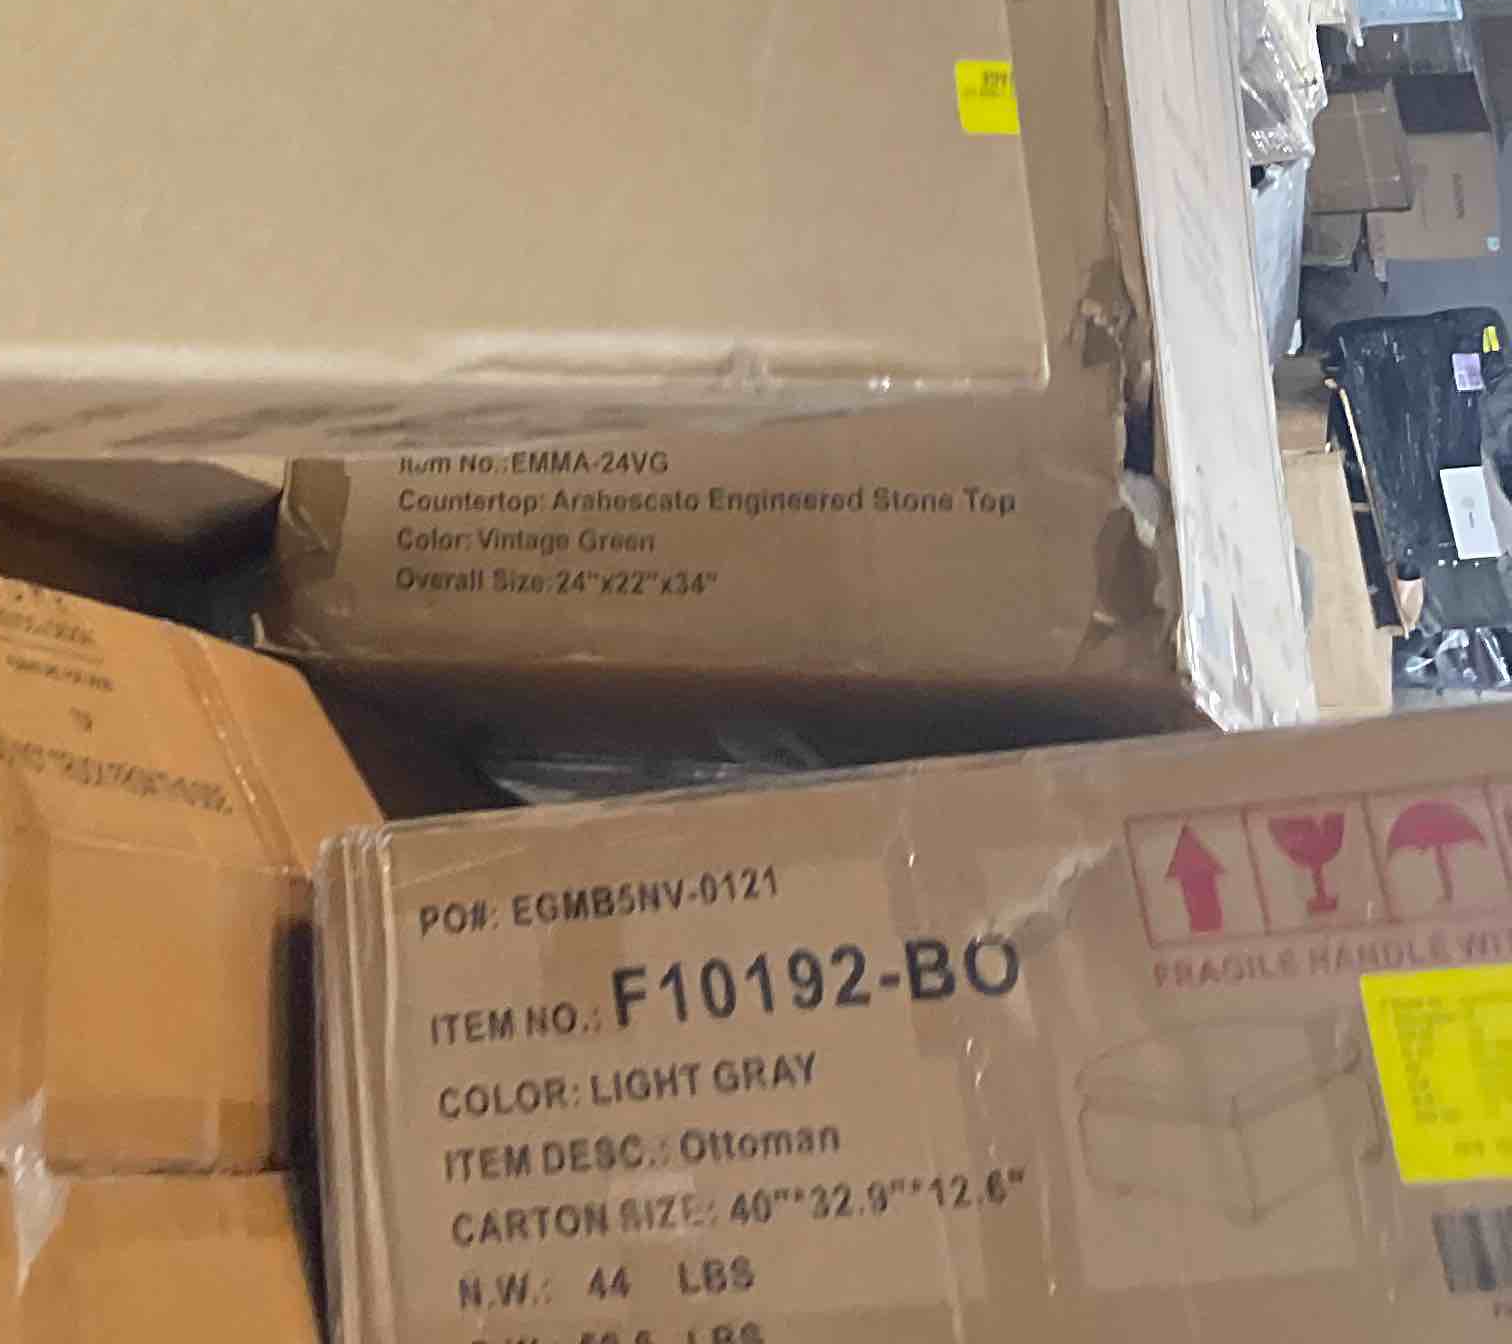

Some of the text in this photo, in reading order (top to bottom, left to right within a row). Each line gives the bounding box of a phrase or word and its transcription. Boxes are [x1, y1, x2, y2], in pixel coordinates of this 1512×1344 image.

[399, 488, 545, 516] Countertop:
[709, 487, 865, 517] Engineered
[872, 486, 954, 512] Stone
[963, 485, 1017, 516] Top
[396, 527, 656, 556] Color: Vintage Green
[395, 566, 485, 593] Overall
[418, 865, 778, 939] PO#: EGMB5NV-0121
[431, 1008, 515, 1046] ITEM
[611, 932, 1021, 1029] F10192-BO
[439, 1051, 817, 1120] COLOR: LIGHT GRAY
[445, 1144, 532, 1183] ITEM
[679, 1124, 841, 1164] Ottoman
[451, 1201, 610, 1247] CARTON
[587, 1264, 632, 1300] 44
[678, 1254, 756, 1296] LBS
